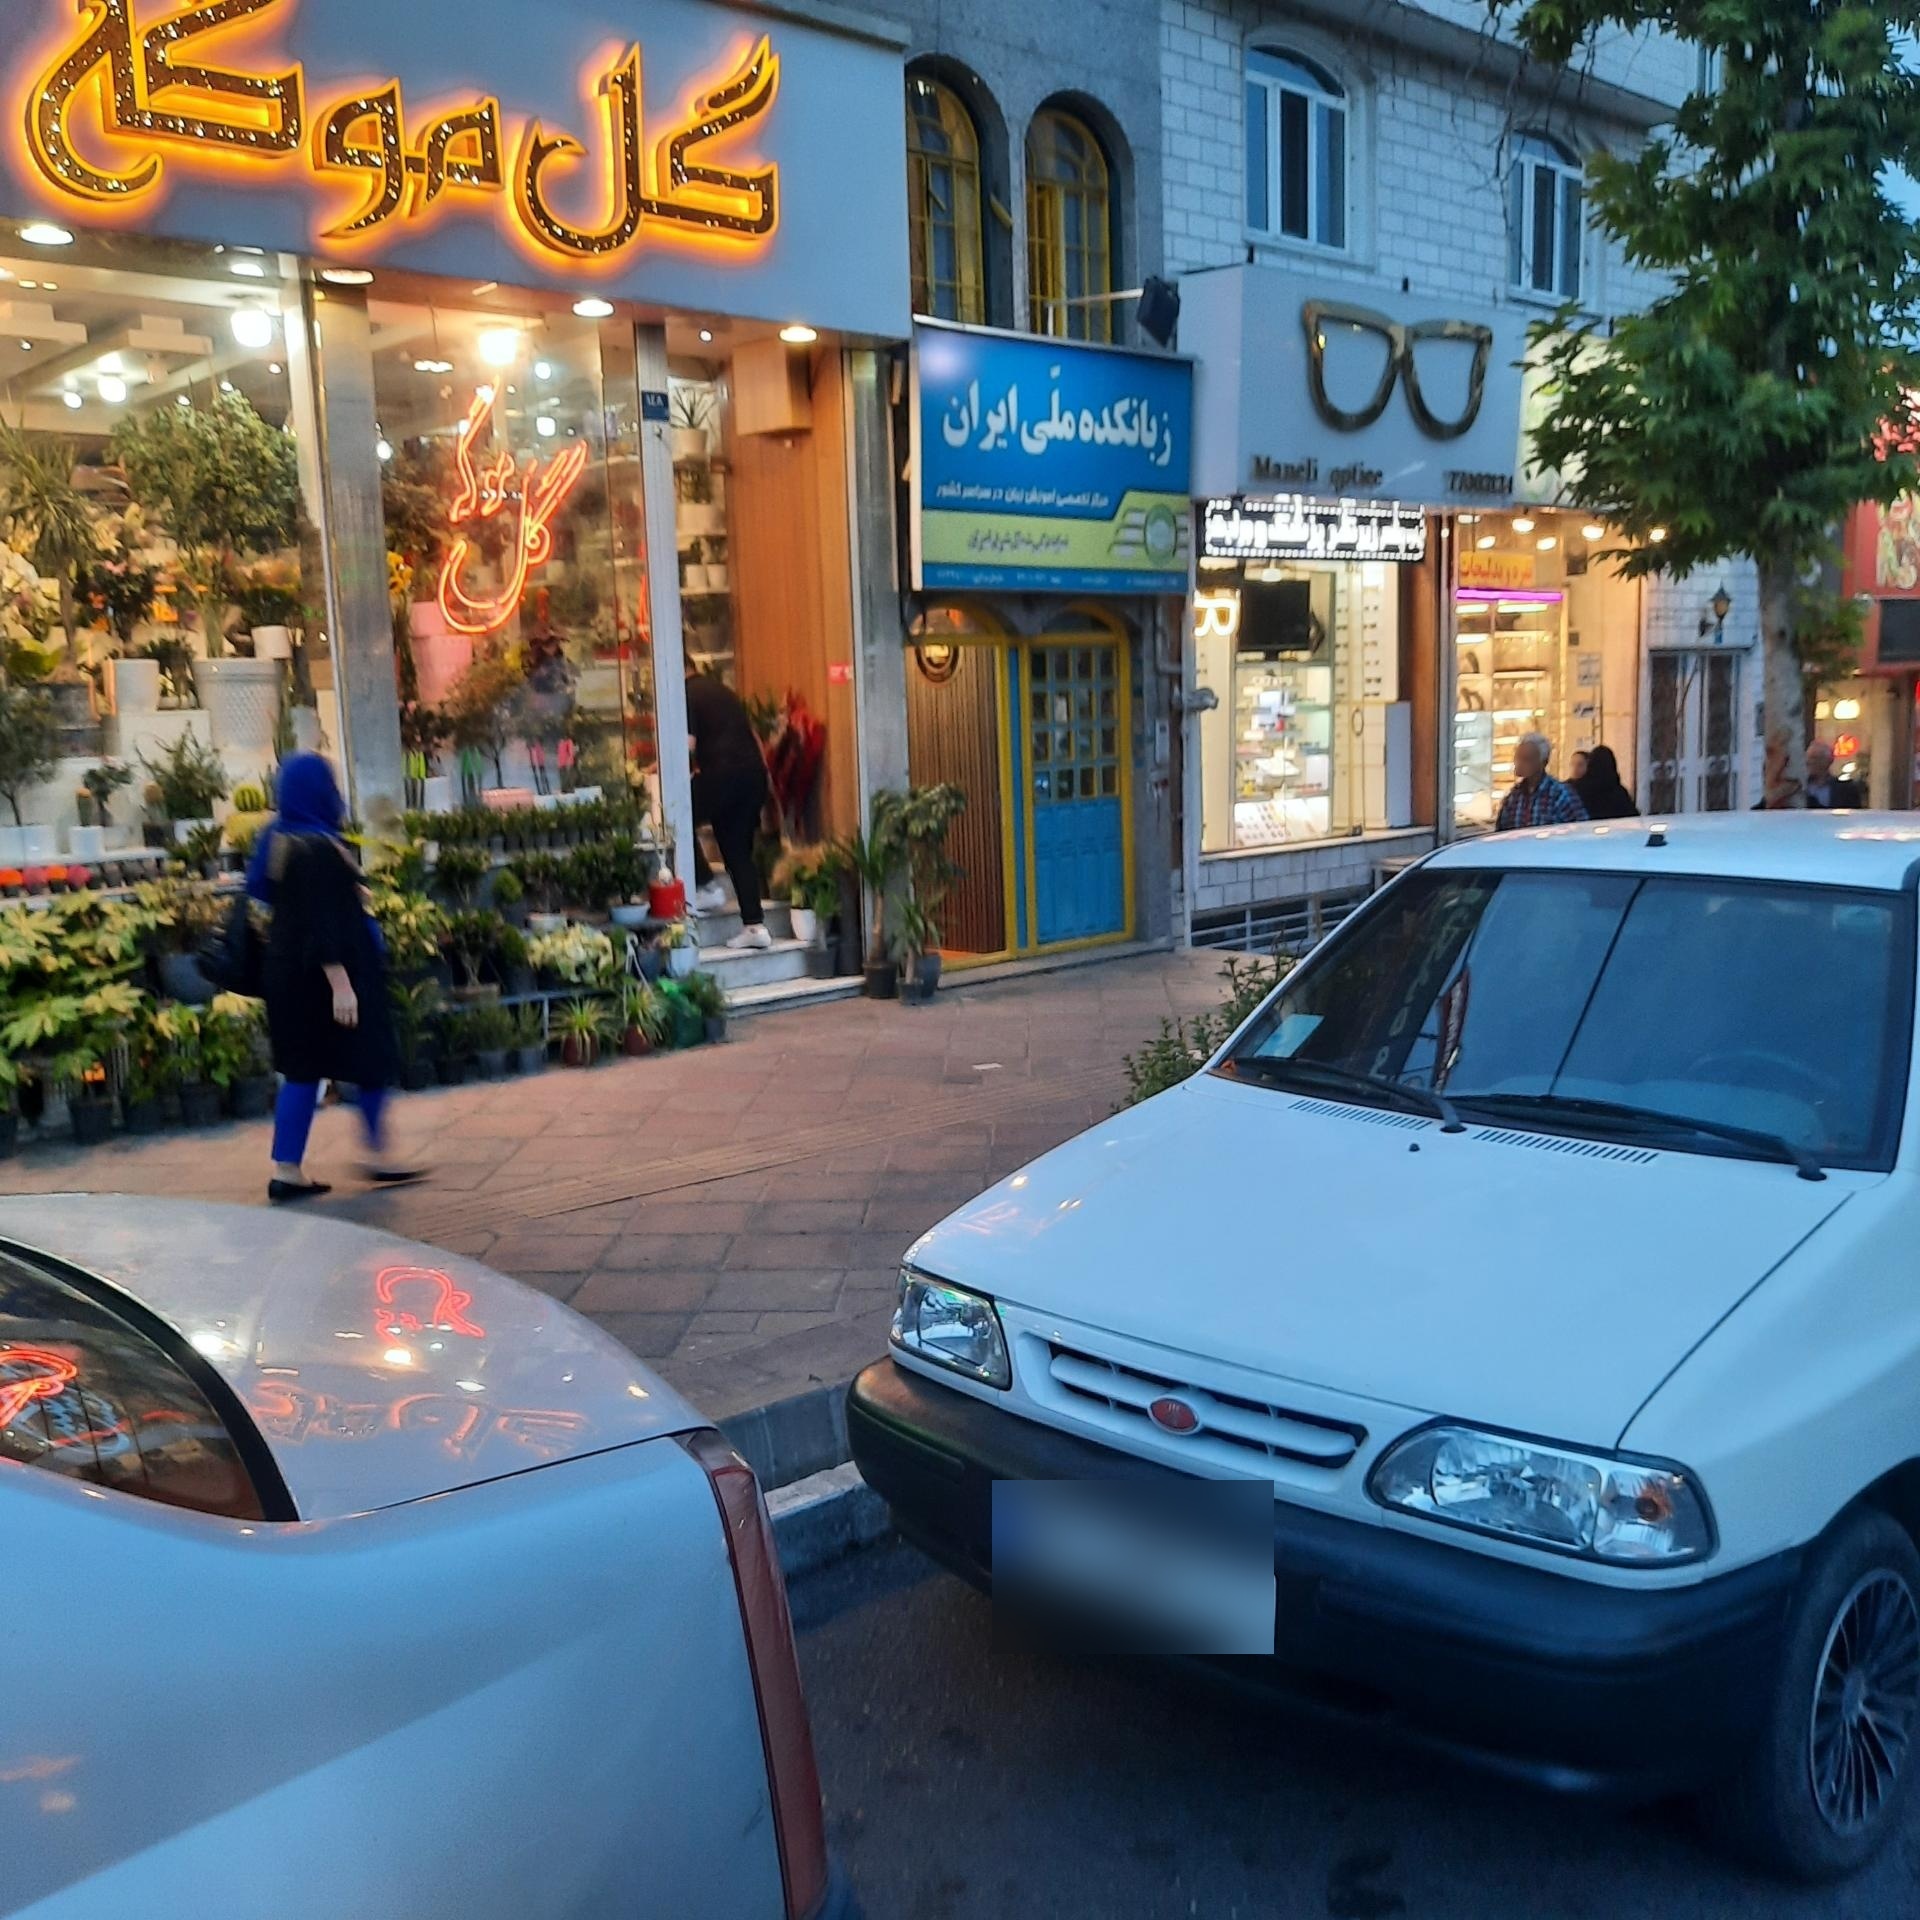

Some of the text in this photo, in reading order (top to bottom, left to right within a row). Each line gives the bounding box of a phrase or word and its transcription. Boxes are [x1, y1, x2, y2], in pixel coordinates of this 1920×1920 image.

[513, 34, 780, 258] گل
[942, 378, 1019, 451] ایران
[1078, 396, 1172, 467] زبانکده
[1250, 454, 1319, 482] Maneli
